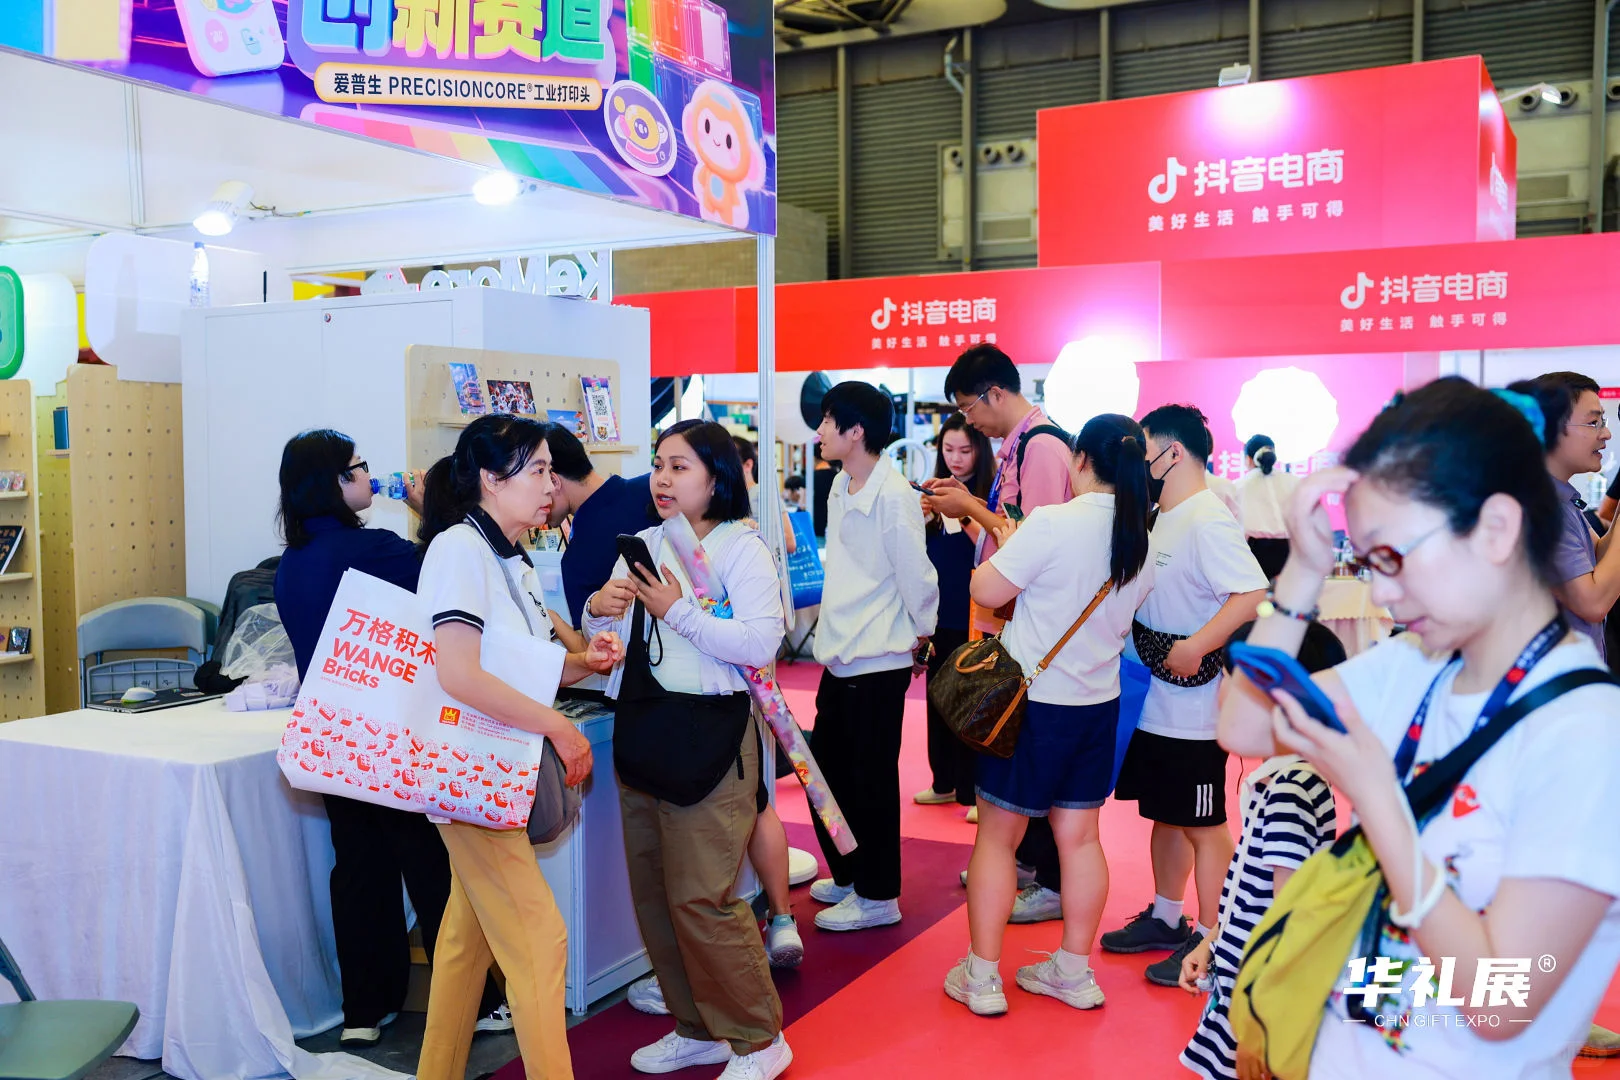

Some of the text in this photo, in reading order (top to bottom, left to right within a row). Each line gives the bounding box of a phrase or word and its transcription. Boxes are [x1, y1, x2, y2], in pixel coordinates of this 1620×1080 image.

[334, 72, 382, 96] 爱普生
[1194, 148, 1344, 197] 抖音电商
[1380, 270, 1508, 305] 抖音电商
[901, 297, 997, 326] 抖音电商
[339, 608, 436, 666] 万格积木
[322, 657, 380, 689] Bricks
[333, 637, 418, 684] WANGE
